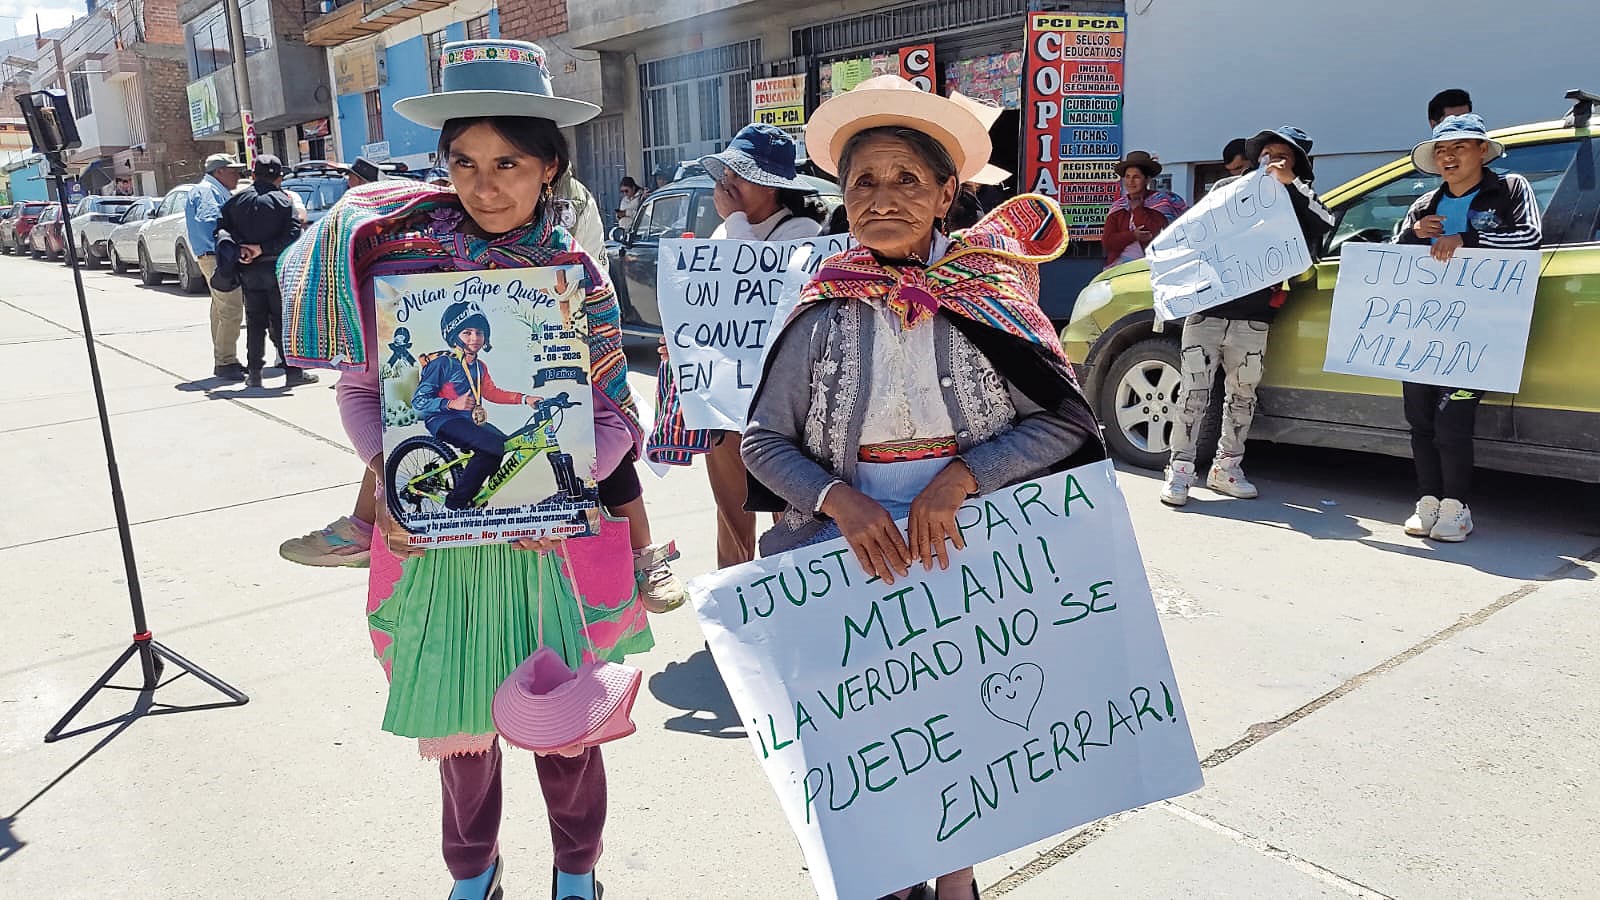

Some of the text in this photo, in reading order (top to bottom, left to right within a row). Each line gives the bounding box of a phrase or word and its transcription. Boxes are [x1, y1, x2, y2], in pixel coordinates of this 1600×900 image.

[1037, 18, 1120, 29] PCI PCA
[1075, 34, 1110, 46] SELLOS
[1065, 46, 1122, 58] EDUCATIVOS
[1071, 73, 1115, 83] PRIMARIA
[1063, 83, 1121, 92] SECUNDARIA
[760, 111, 776, 123] PCI
[782, 110, 799, 122] PCA
[1068, 112, 1113, 124] NACIONAL
[1073, 129, 1108, 141] FICHAS
[1061, 143, 1118, 155] DE TRABAJO
[1062, 162, 1116, 171] REGISTROS
[1062, 172, 1118, 180] AUXILIARES
[1107, 183, 1117, 193] DE
[1064, 194, 1114, 204] OLIMPIADAS
[1363, 249, 1528, 296] JUSTICIA
[685, 279, 719, 307] UN
[396, 287, 448, 323] Milan
[506, 279, 556, 309] Quispe
[1359, 296, 1467, 332] PARA
[1346, 332, 1489, 376] MILAN
[555, 367, 577, 379] años
[678, 359, 714, 395] EN
[954, 473, 1095, 548] PARA
[481, 530, 498, 540] Hoy
[502, 527, 537, 538] mañana
[540, 527, 546, 536] y
[551, 524, 585, 535] siempre
[842, 536, 1060, 668] MILAN!
[817, 640, 963, 720] VERDAD
[976, 608, 1039, 665] NO
[1052, 580, 1118, 626] SE
[936, 680, 1178, 842] ENTERRAR!
[803, 713, 963, 825] PUEDE
